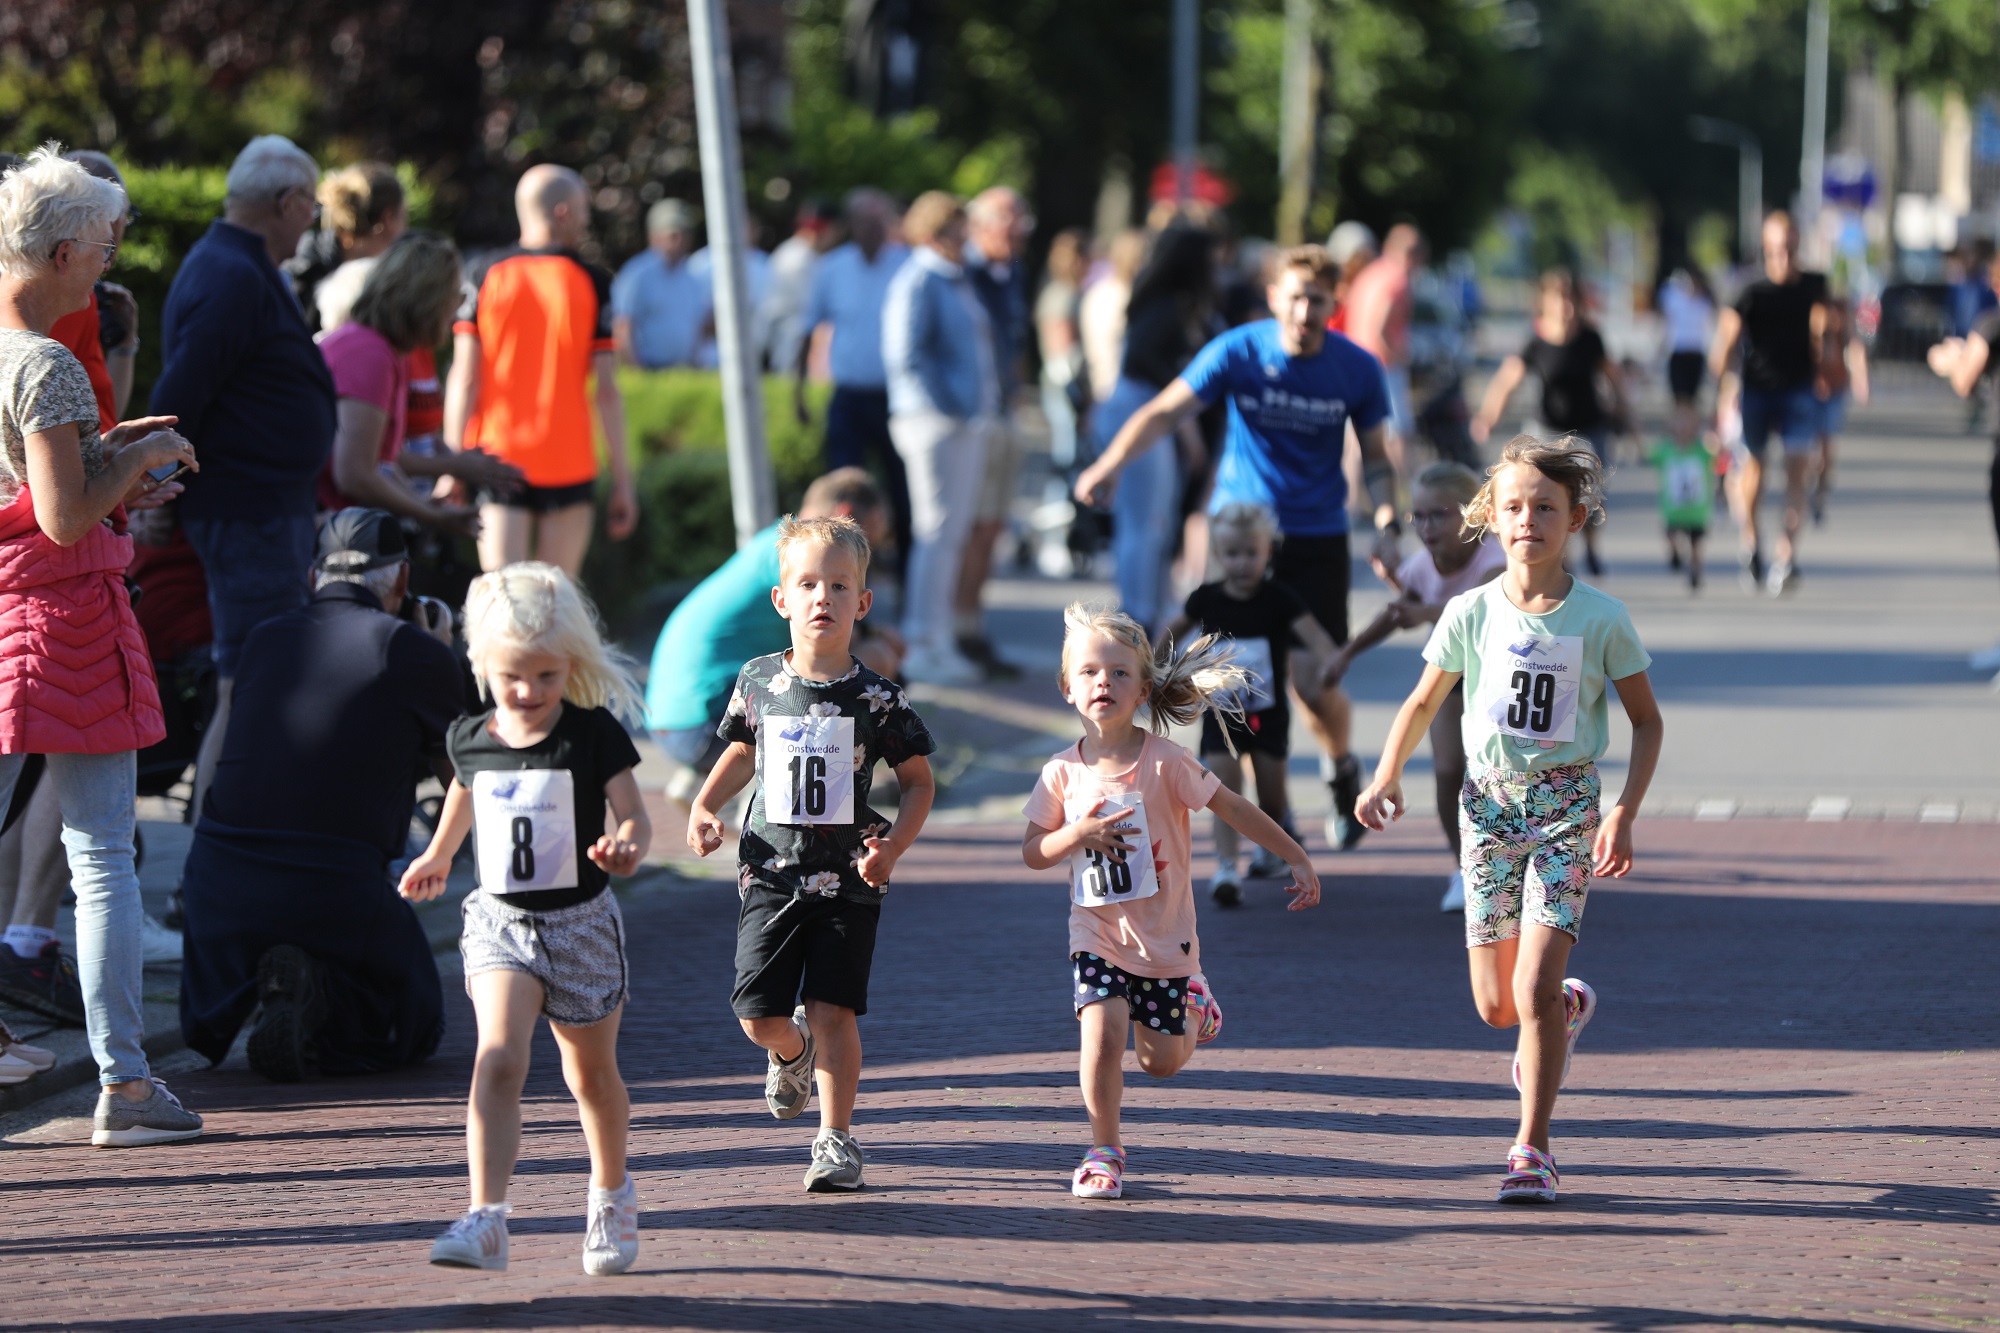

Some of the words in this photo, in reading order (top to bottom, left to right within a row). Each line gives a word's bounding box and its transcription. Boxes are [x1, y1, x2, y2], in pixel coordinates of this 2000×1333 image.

[1514, 659, 1568, 672] Onstwedde
[1507, 670, 1556, 733] 39
[787, 744, 840, 754] Onstwedde
[788, 755, 826, 816] 16
[511, 816, 535, 882] 8
[1085, 834, 1133, 898] 38
